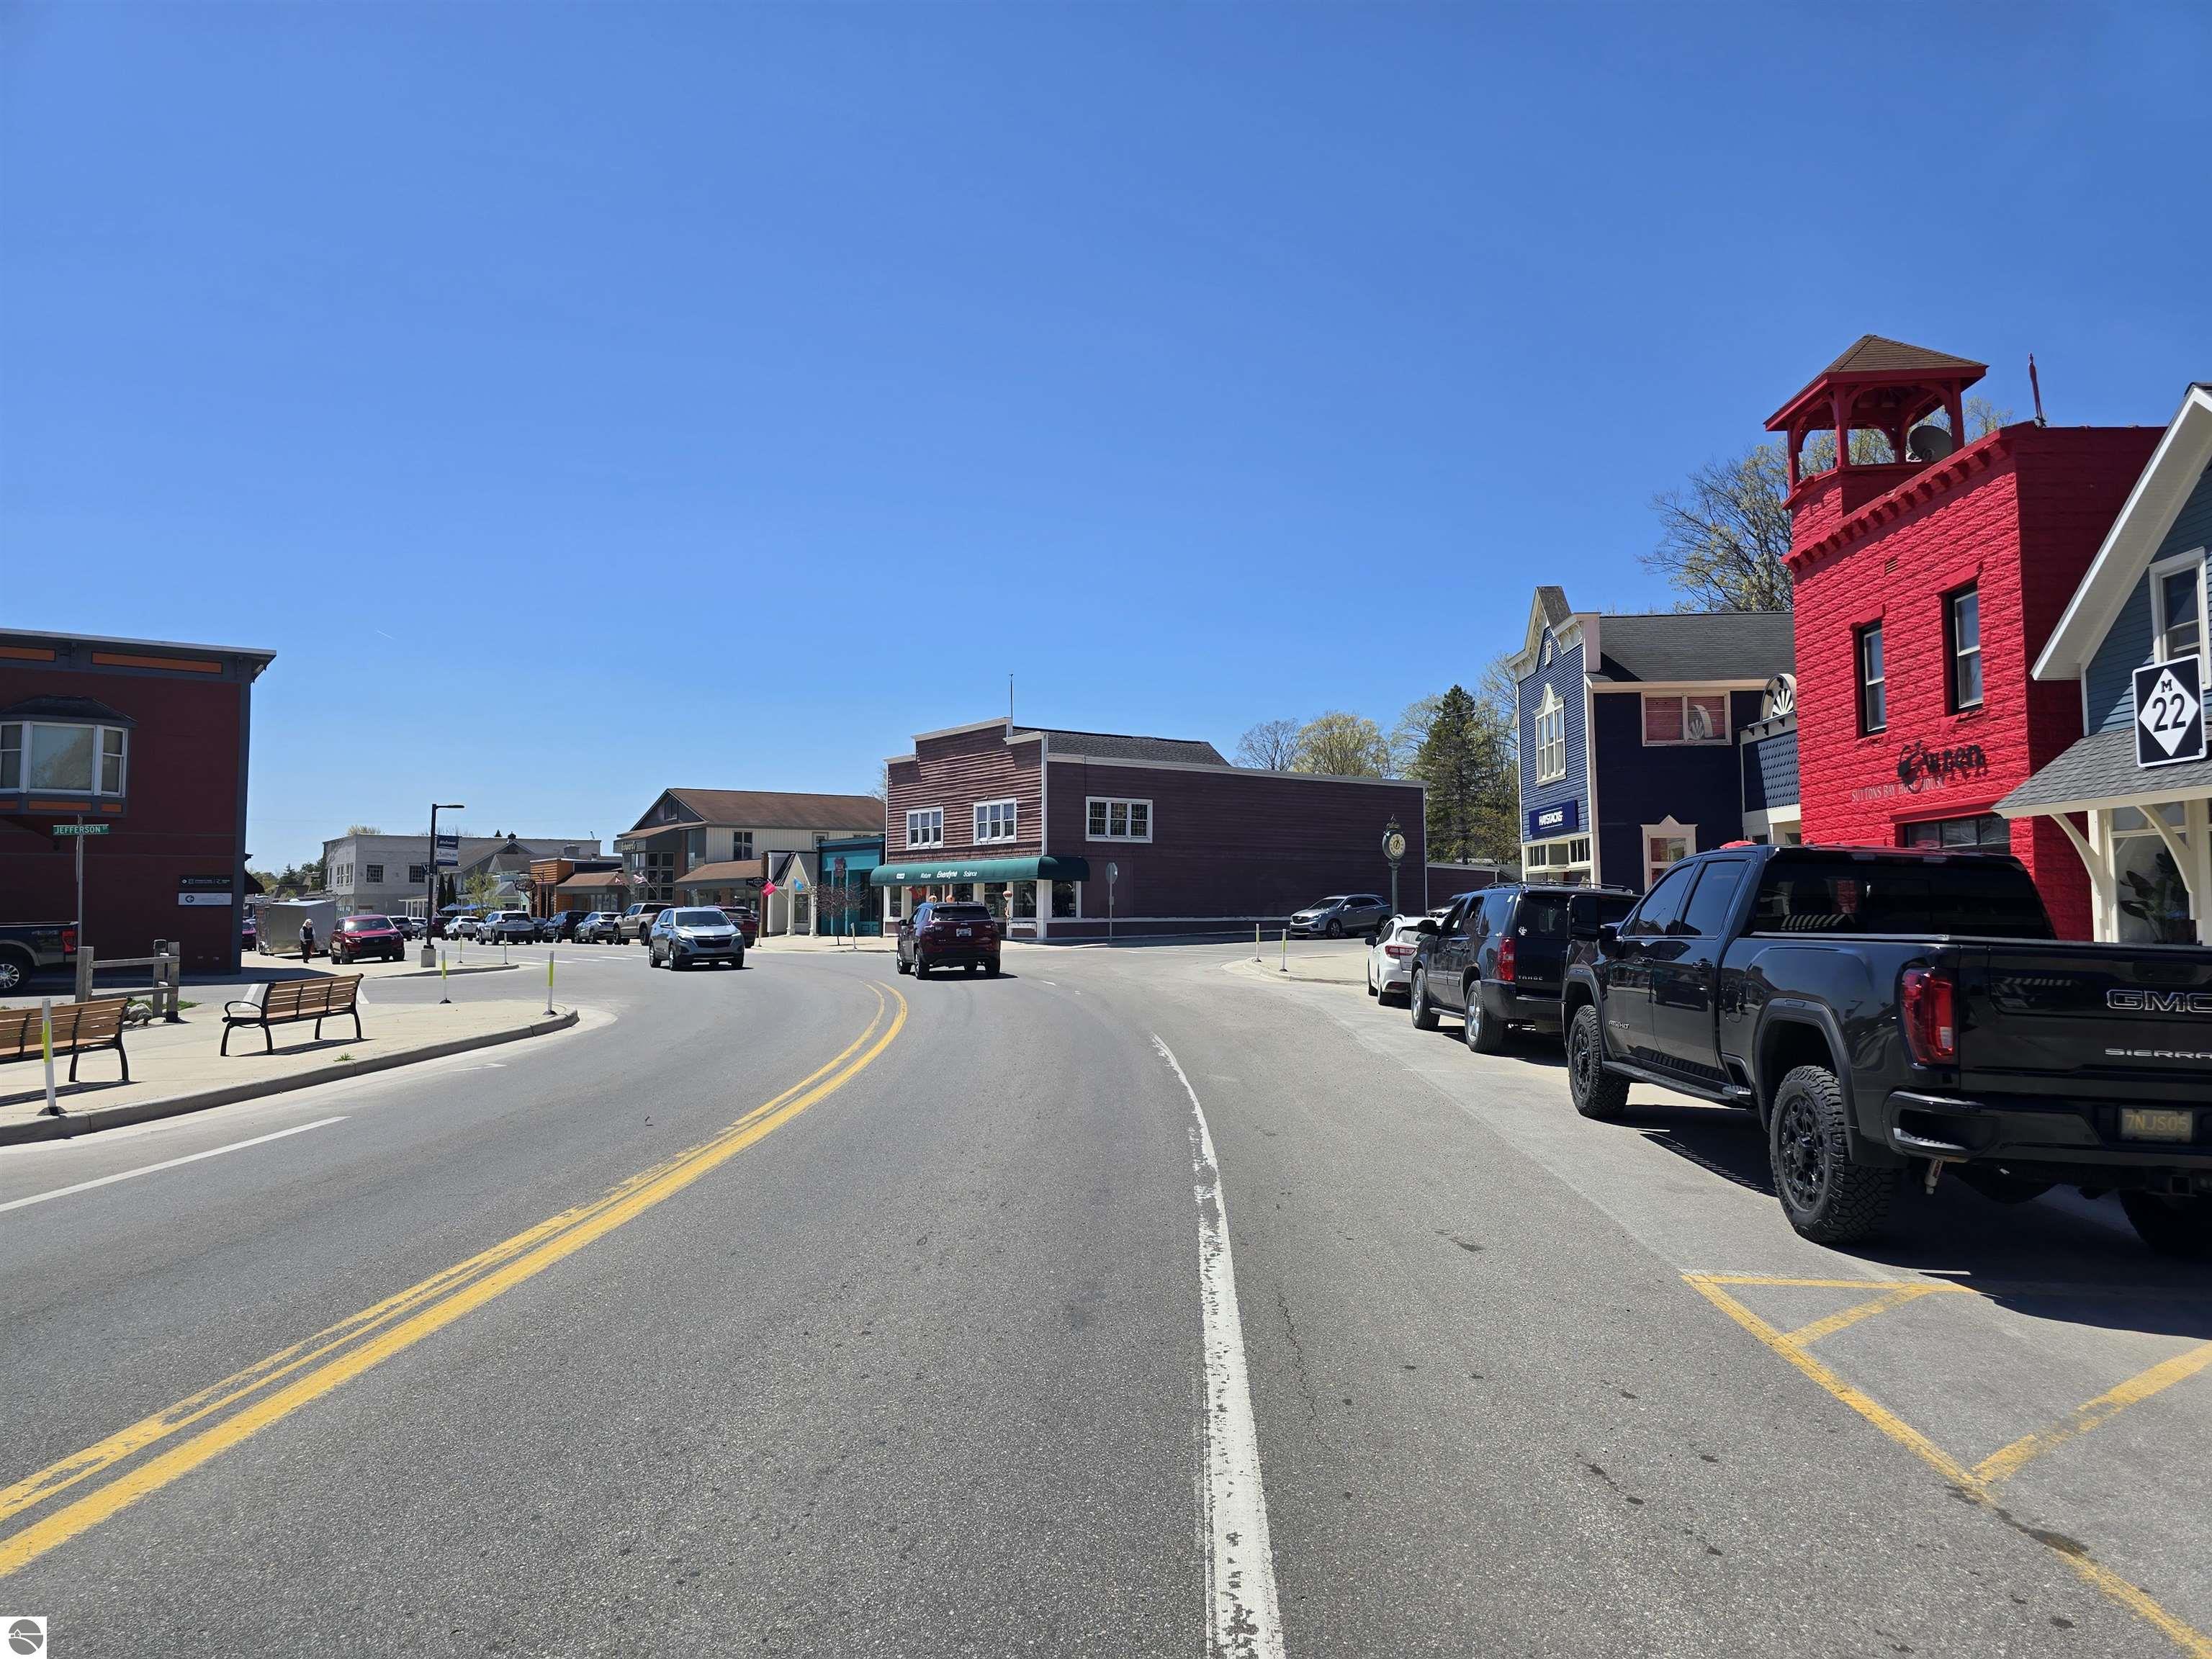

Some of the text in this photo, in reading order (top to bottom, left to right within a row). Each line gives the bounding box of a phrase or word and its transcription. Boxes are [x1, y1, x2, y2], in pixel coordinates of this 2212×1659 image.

[2160, 679, 2172, 693] M
[2152, 693, 2186, 733] 22
[1851, 786, 1881, 802] SUTTONS
[1883, 783, 1895, 797] BAY
[2106, 989, 2212, 1013] GMC
[2105, 1048, 2212, 1059] SIERRA
